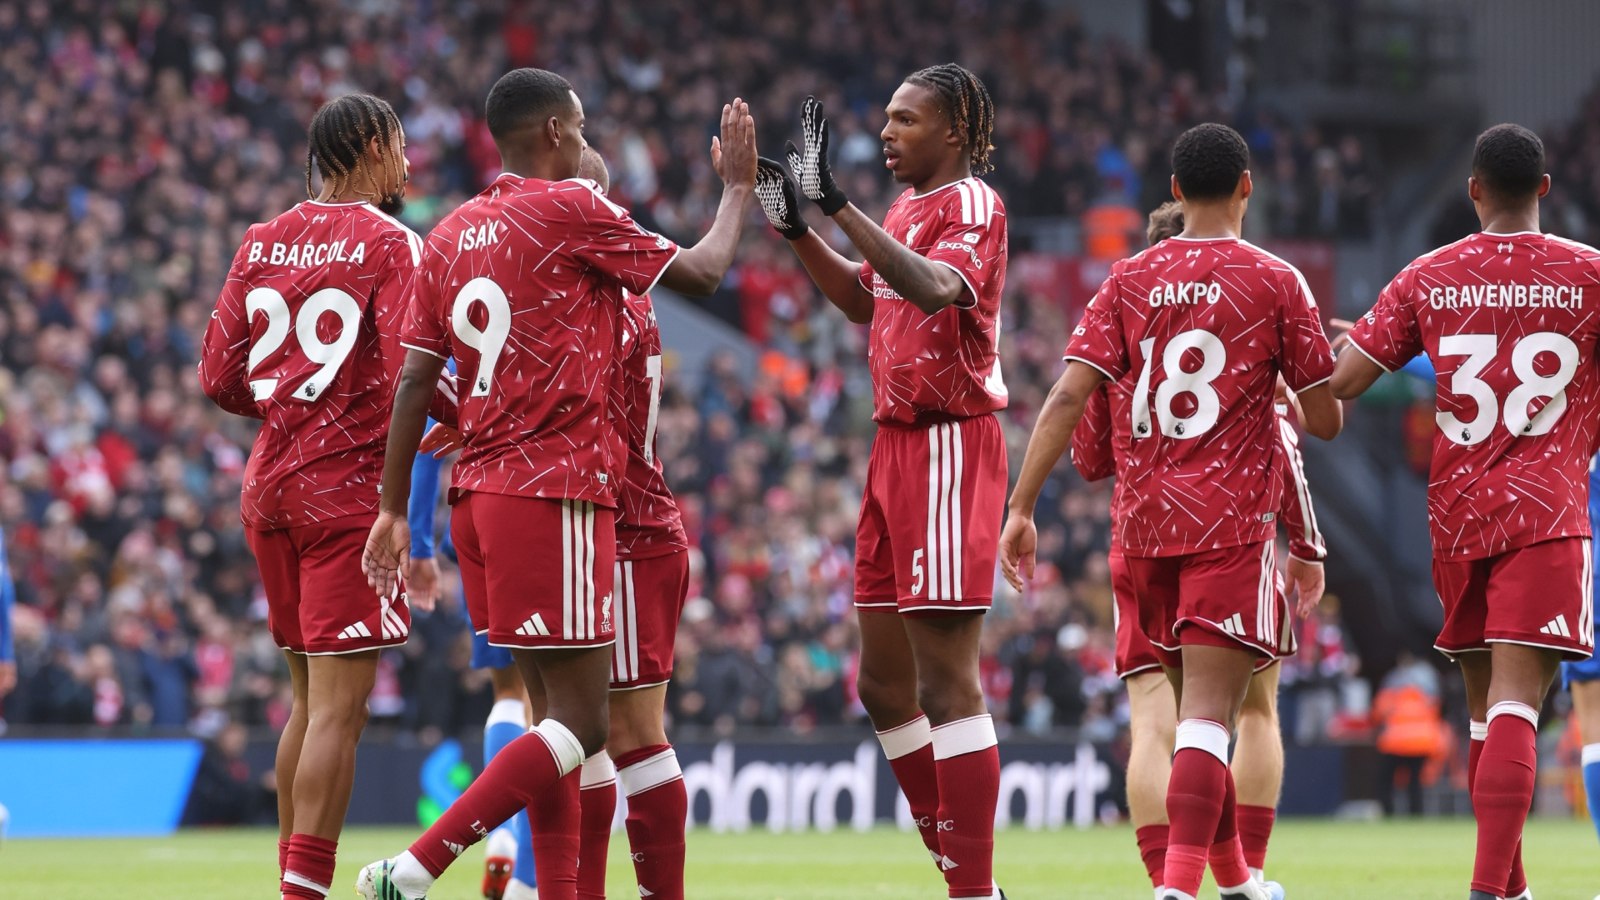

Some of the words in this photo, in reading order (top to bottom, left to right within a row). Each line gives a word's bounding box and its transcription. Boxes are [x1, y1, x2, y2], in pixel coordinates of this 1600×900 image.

[249, 241, 366, 267] B.BARCOLA
[458, 220, 499, 252] ISAK
[1149, 282, 1222, 308] GAKPO
[1430, 284, 1584, 311] GRAVENBERCH
[246, 287, 362, 402] 29
[452, 276, 512, 397] 9
[1132, 328, 1227, 440] 18
[1436, 331, 1580, 446] 38
[911, 548, 924, 596] 5
[683, 741, 878, 834] dard
[937, 820, 954, 832] FC
